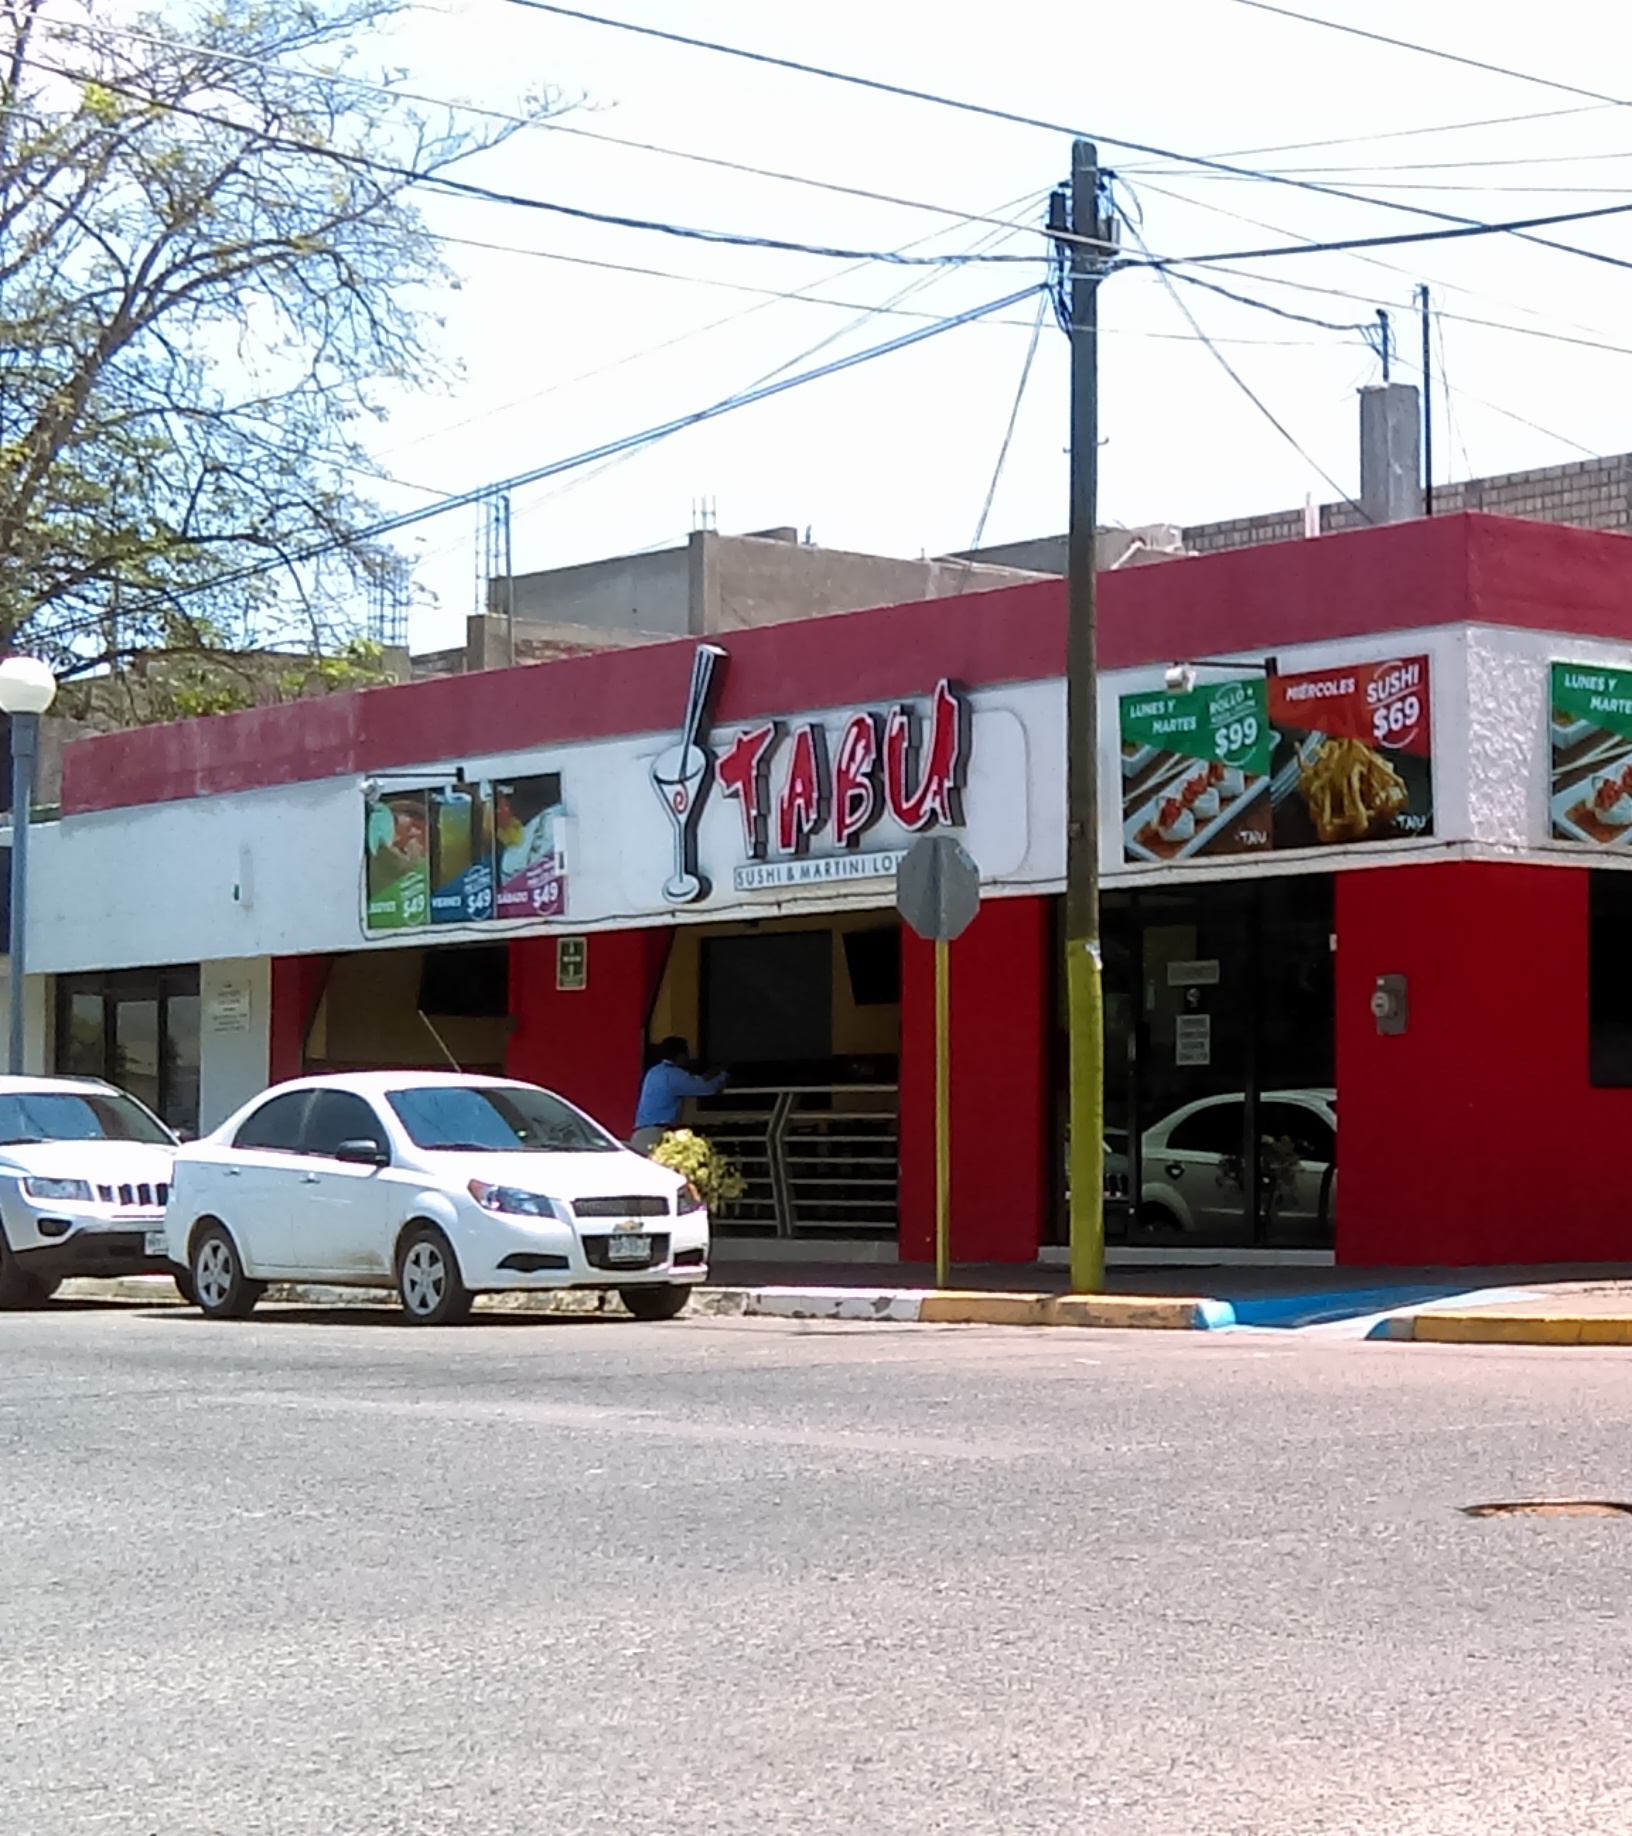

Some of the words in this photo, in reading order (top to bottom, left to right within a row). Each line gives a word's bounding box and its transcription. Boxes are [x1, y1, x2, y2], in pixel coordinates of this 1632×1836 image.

[1367, 664, 1420, 703] SUSHI
[1564, 673, 1605, 691] LUNES
[1607, 678, 1618, 692] Y
[1130, 701, 1165, 718] LUNES
[1167, 699, 1176, 713] Y
[1373, 696, 1420, 740] $69
[1152, 716, 1197, 734] MARTES
[1214, 716, 1258, 757] $99
[715, 677, 968, 858] TABU
[737, 867, 781, 887] SUSHI
[786, 866, 796, 882] &
[801, 860, 866, 881] MARTINI
[467, 888, 491, 913] $49
[533, 881, 558, 907] $49
